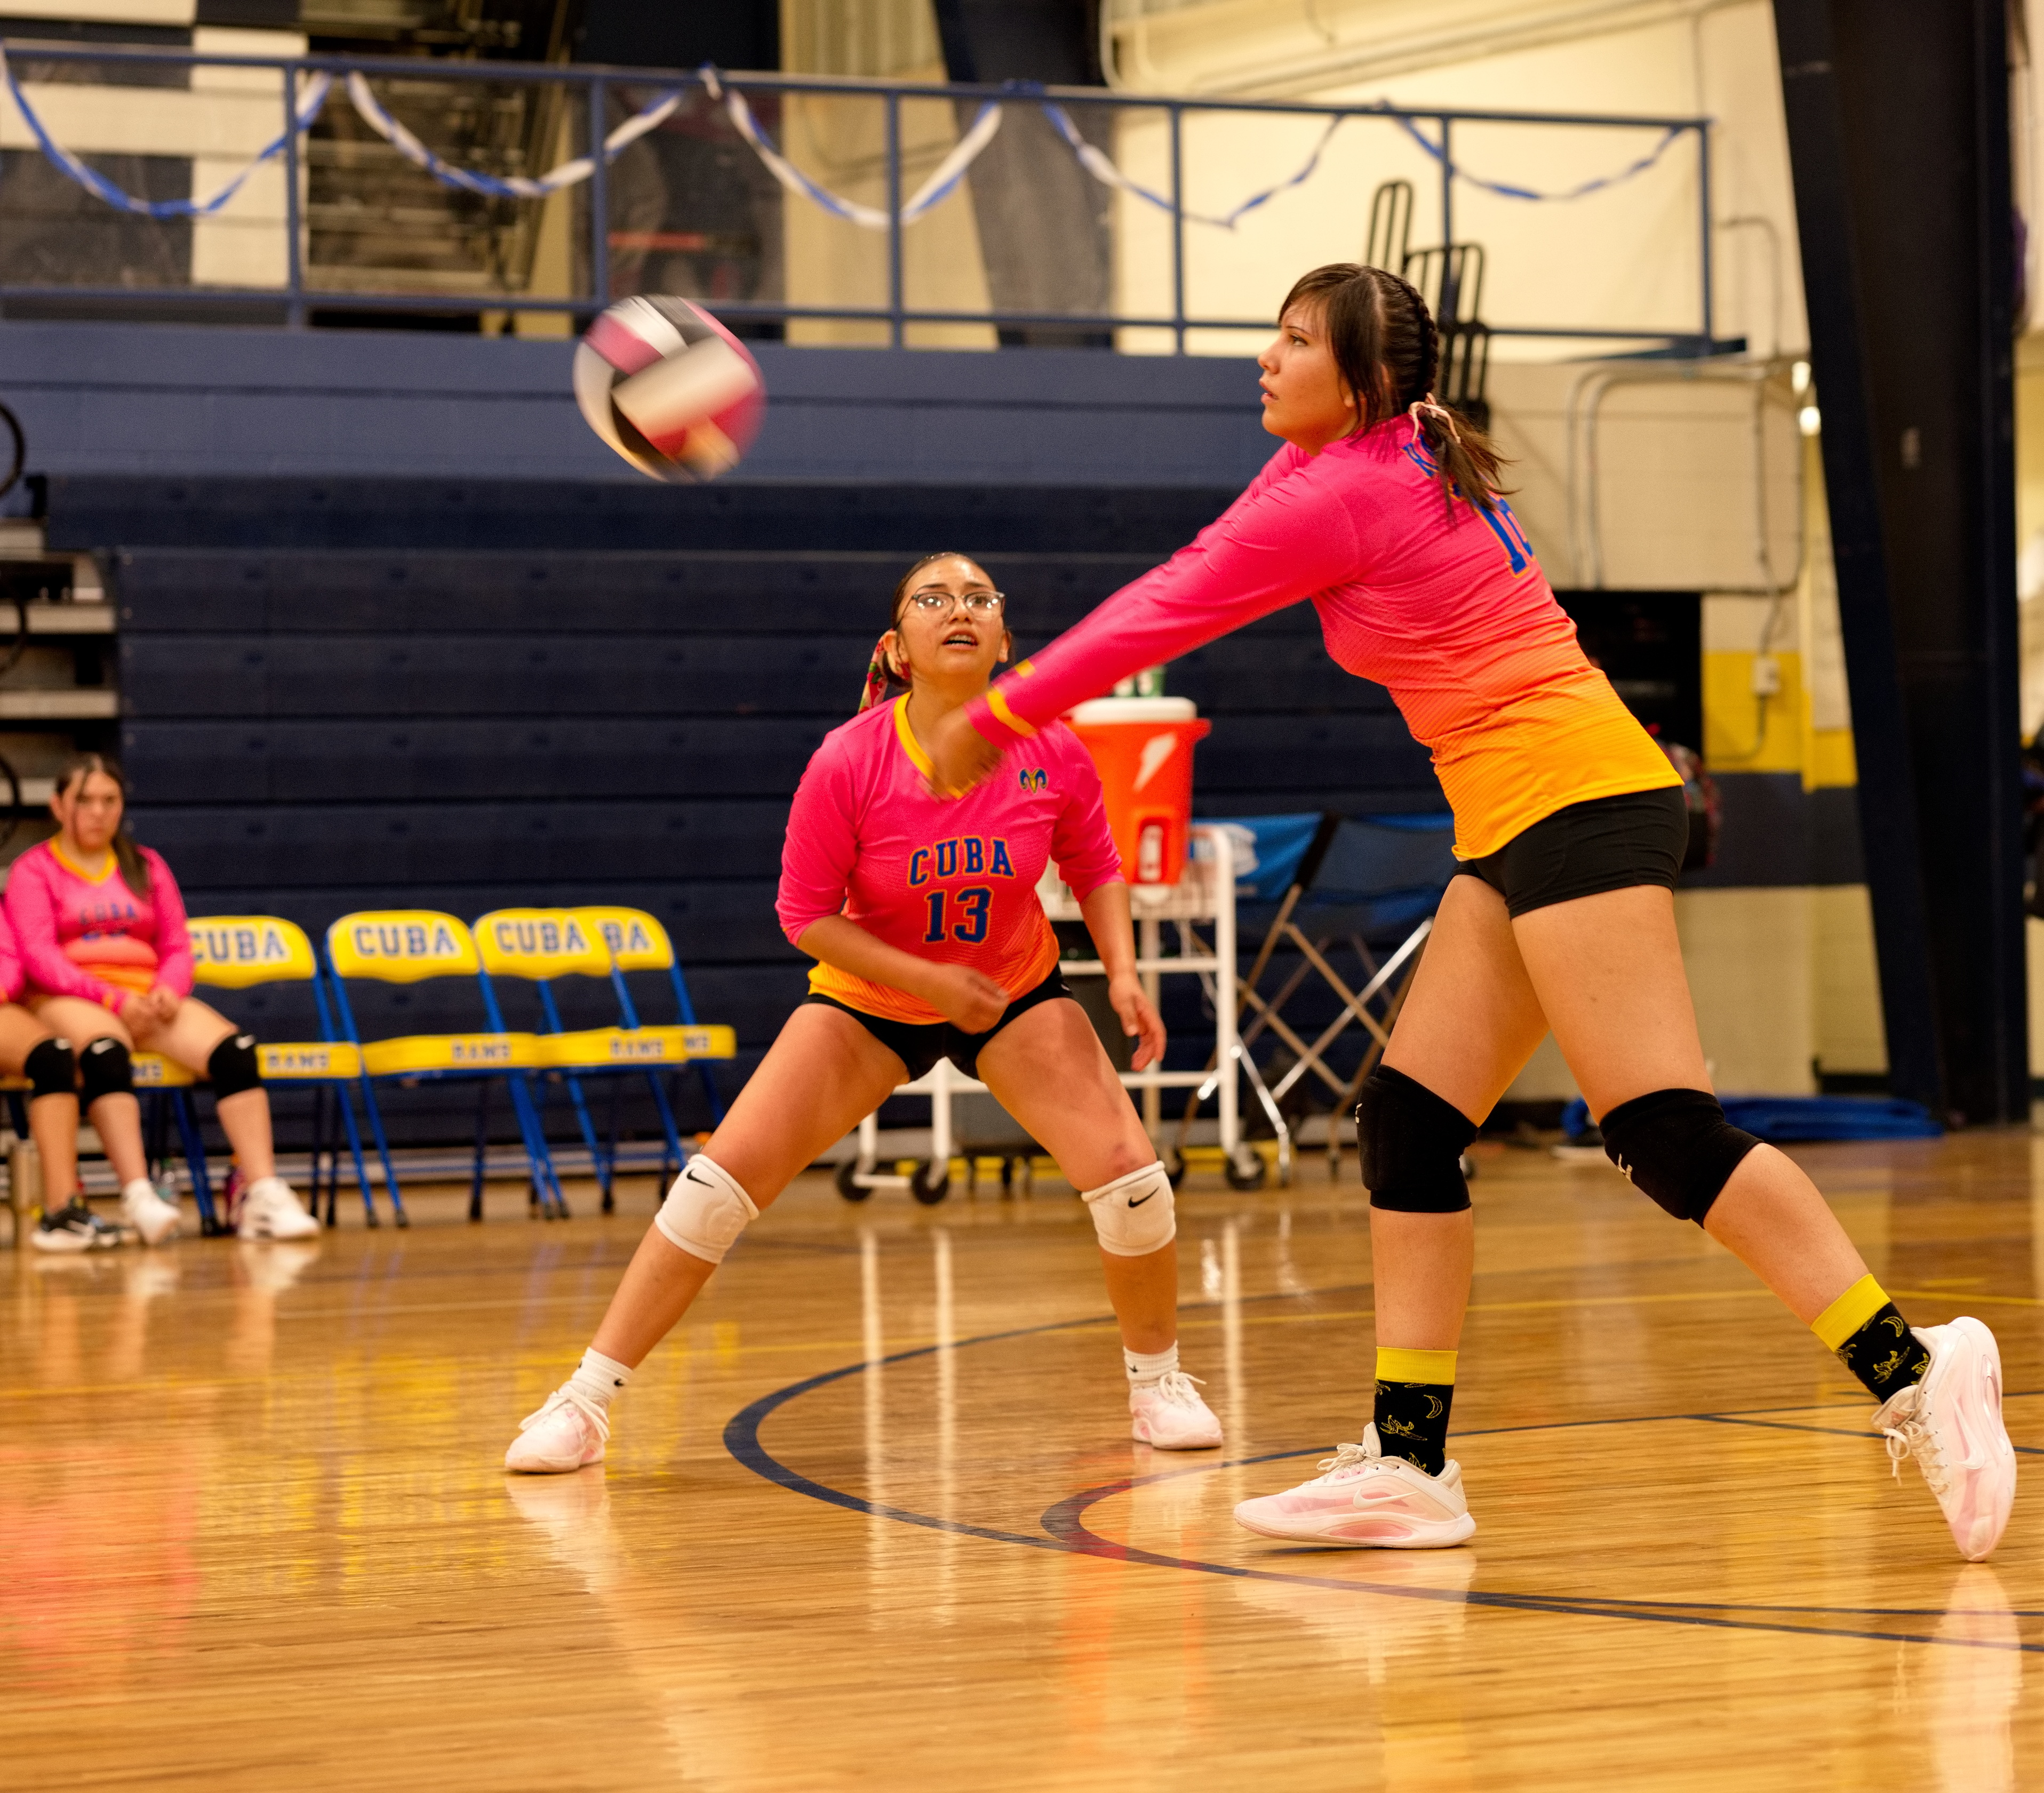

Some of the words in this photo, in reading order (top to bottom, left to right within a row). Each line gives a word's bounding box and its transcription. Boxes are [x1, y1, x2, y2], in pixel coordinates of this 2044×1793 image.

[907, 835, 1016, 888] CUBA
[494, 920, 587, 953] CUBA
[922, 884, 994, 946] 13
[354, 924, 457, 957] CUBA
